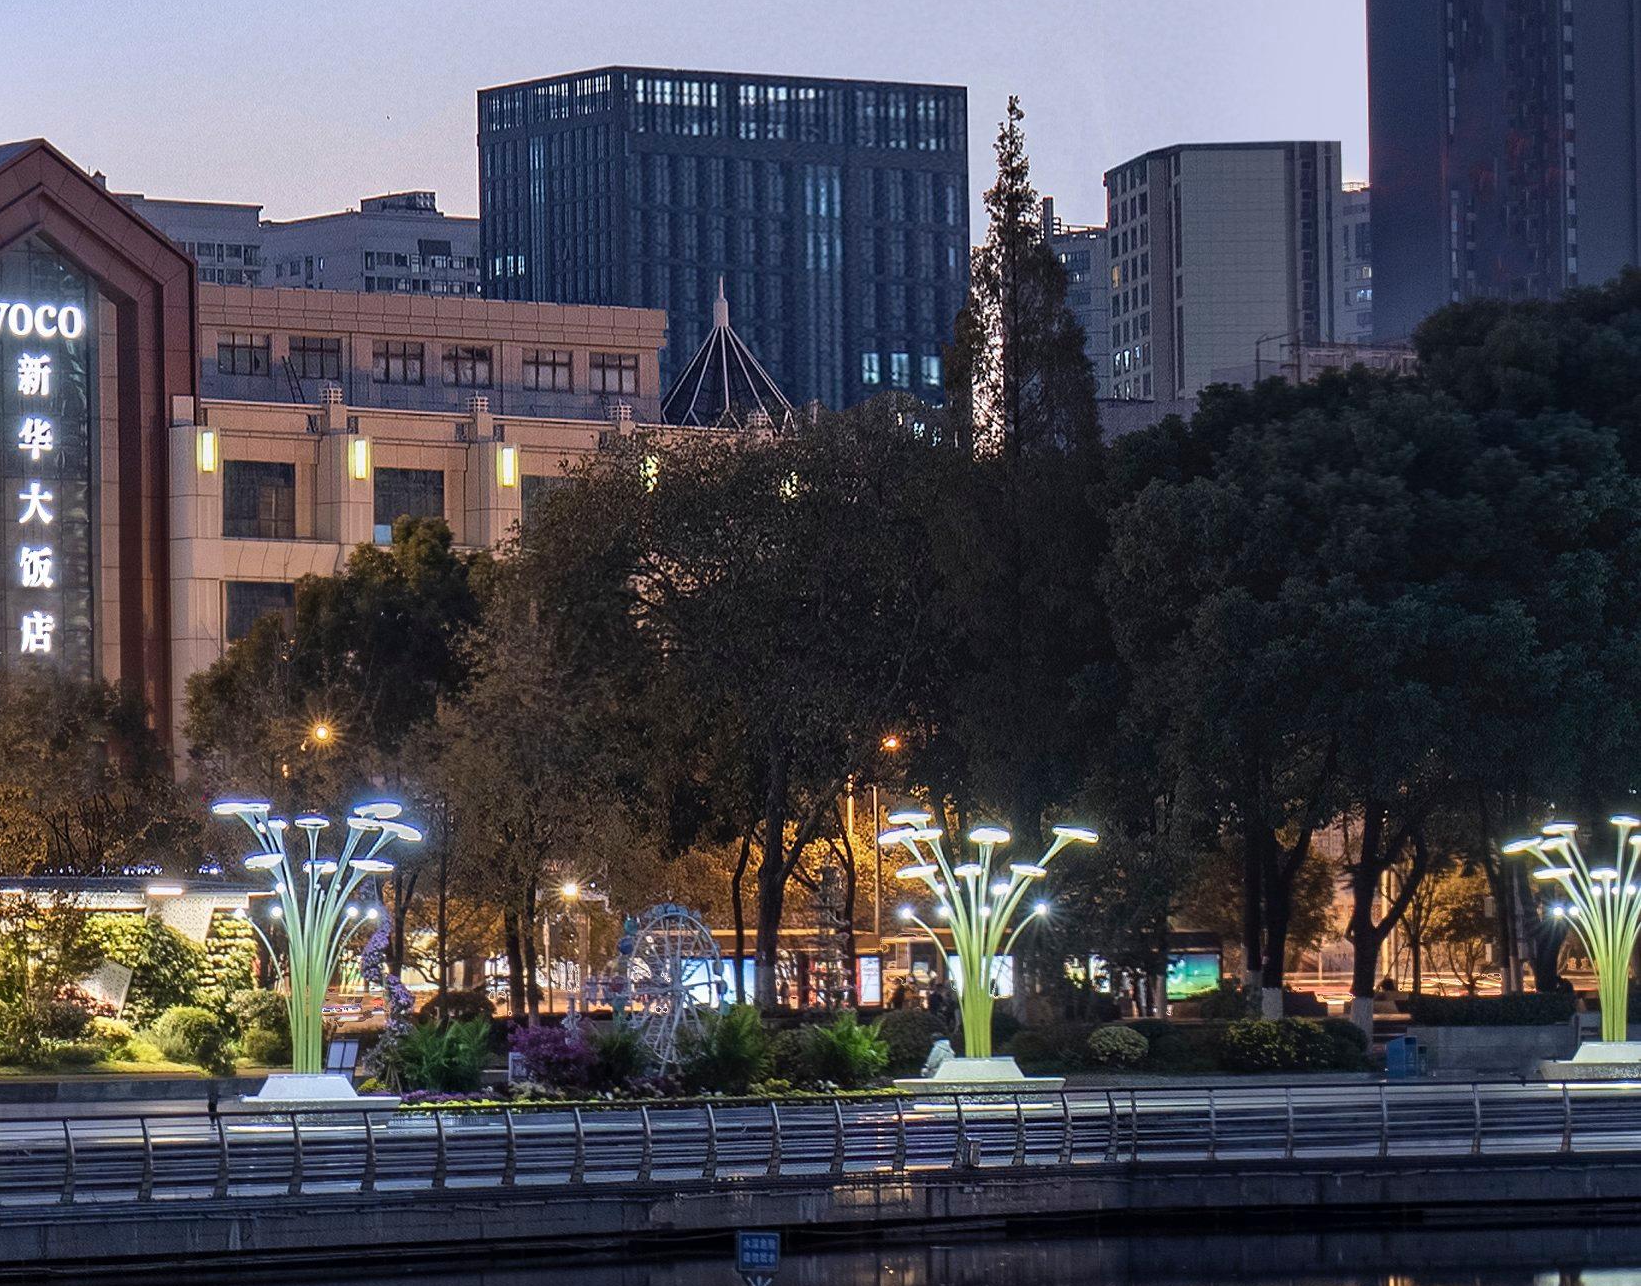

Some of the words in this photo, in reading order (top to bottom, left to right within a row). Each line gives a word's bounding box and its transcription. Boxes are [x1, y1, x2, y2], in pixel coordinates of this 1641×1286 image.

[17, 352, 55, 655] 新华大饭店
